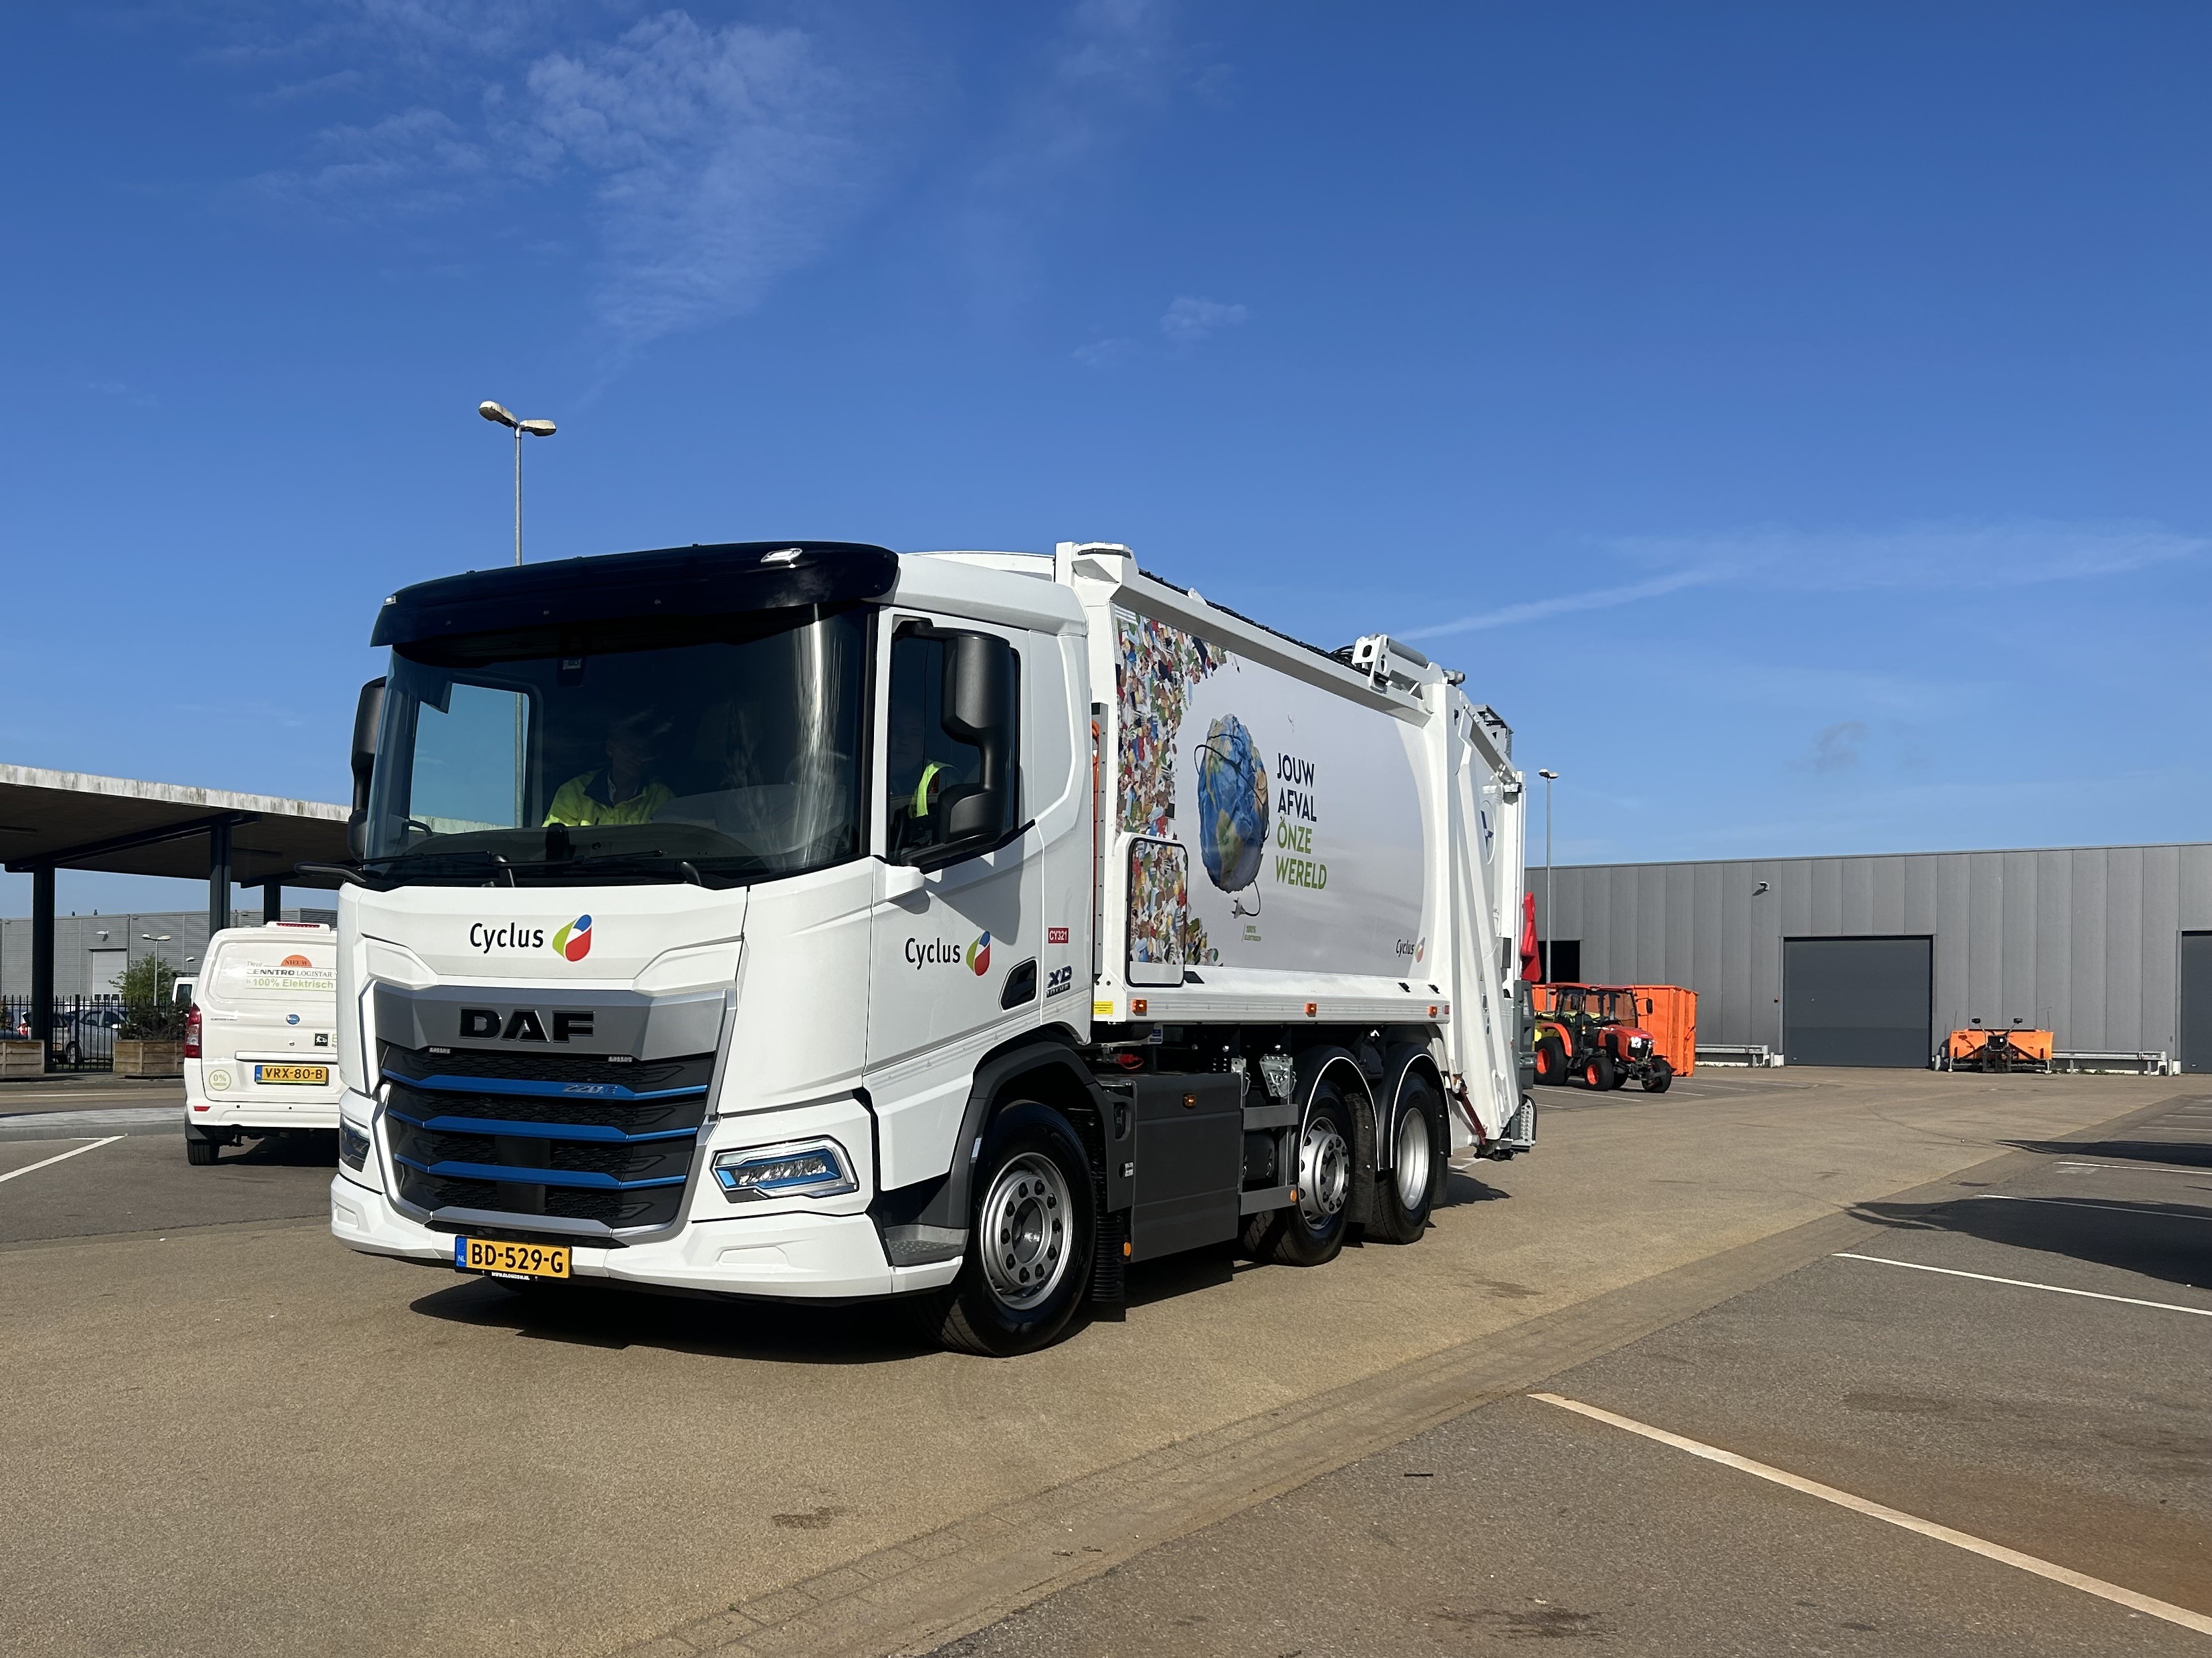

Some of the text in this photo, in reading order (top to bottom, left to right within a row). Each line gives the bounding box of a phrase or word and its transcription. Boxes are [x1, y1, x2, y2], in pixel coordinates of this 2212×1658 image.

[1277, 753, 1315, 788] JOUW
[1277, 787, 1317, 822] AFVAL
[1277, 821, 1312, 854] ONZE
[1275, 856, 1327, 889] WERELD
[470, 922, 544, 954] Cyclus
[1049, 930, 1067, 941] CY321
[1396, 939, 1414, 957] Cyclus
[905, 937, 960, 970] Cyclus
[282, 979, 334, 989] Elektrisch
[1047, 965, 1073, 989] XD
[459, 1007, 596, 1043] DAF
[264, 1068, 323, 1080] VRX-80-B
[458, 1243, 564, 1273] NL BD-529-G
